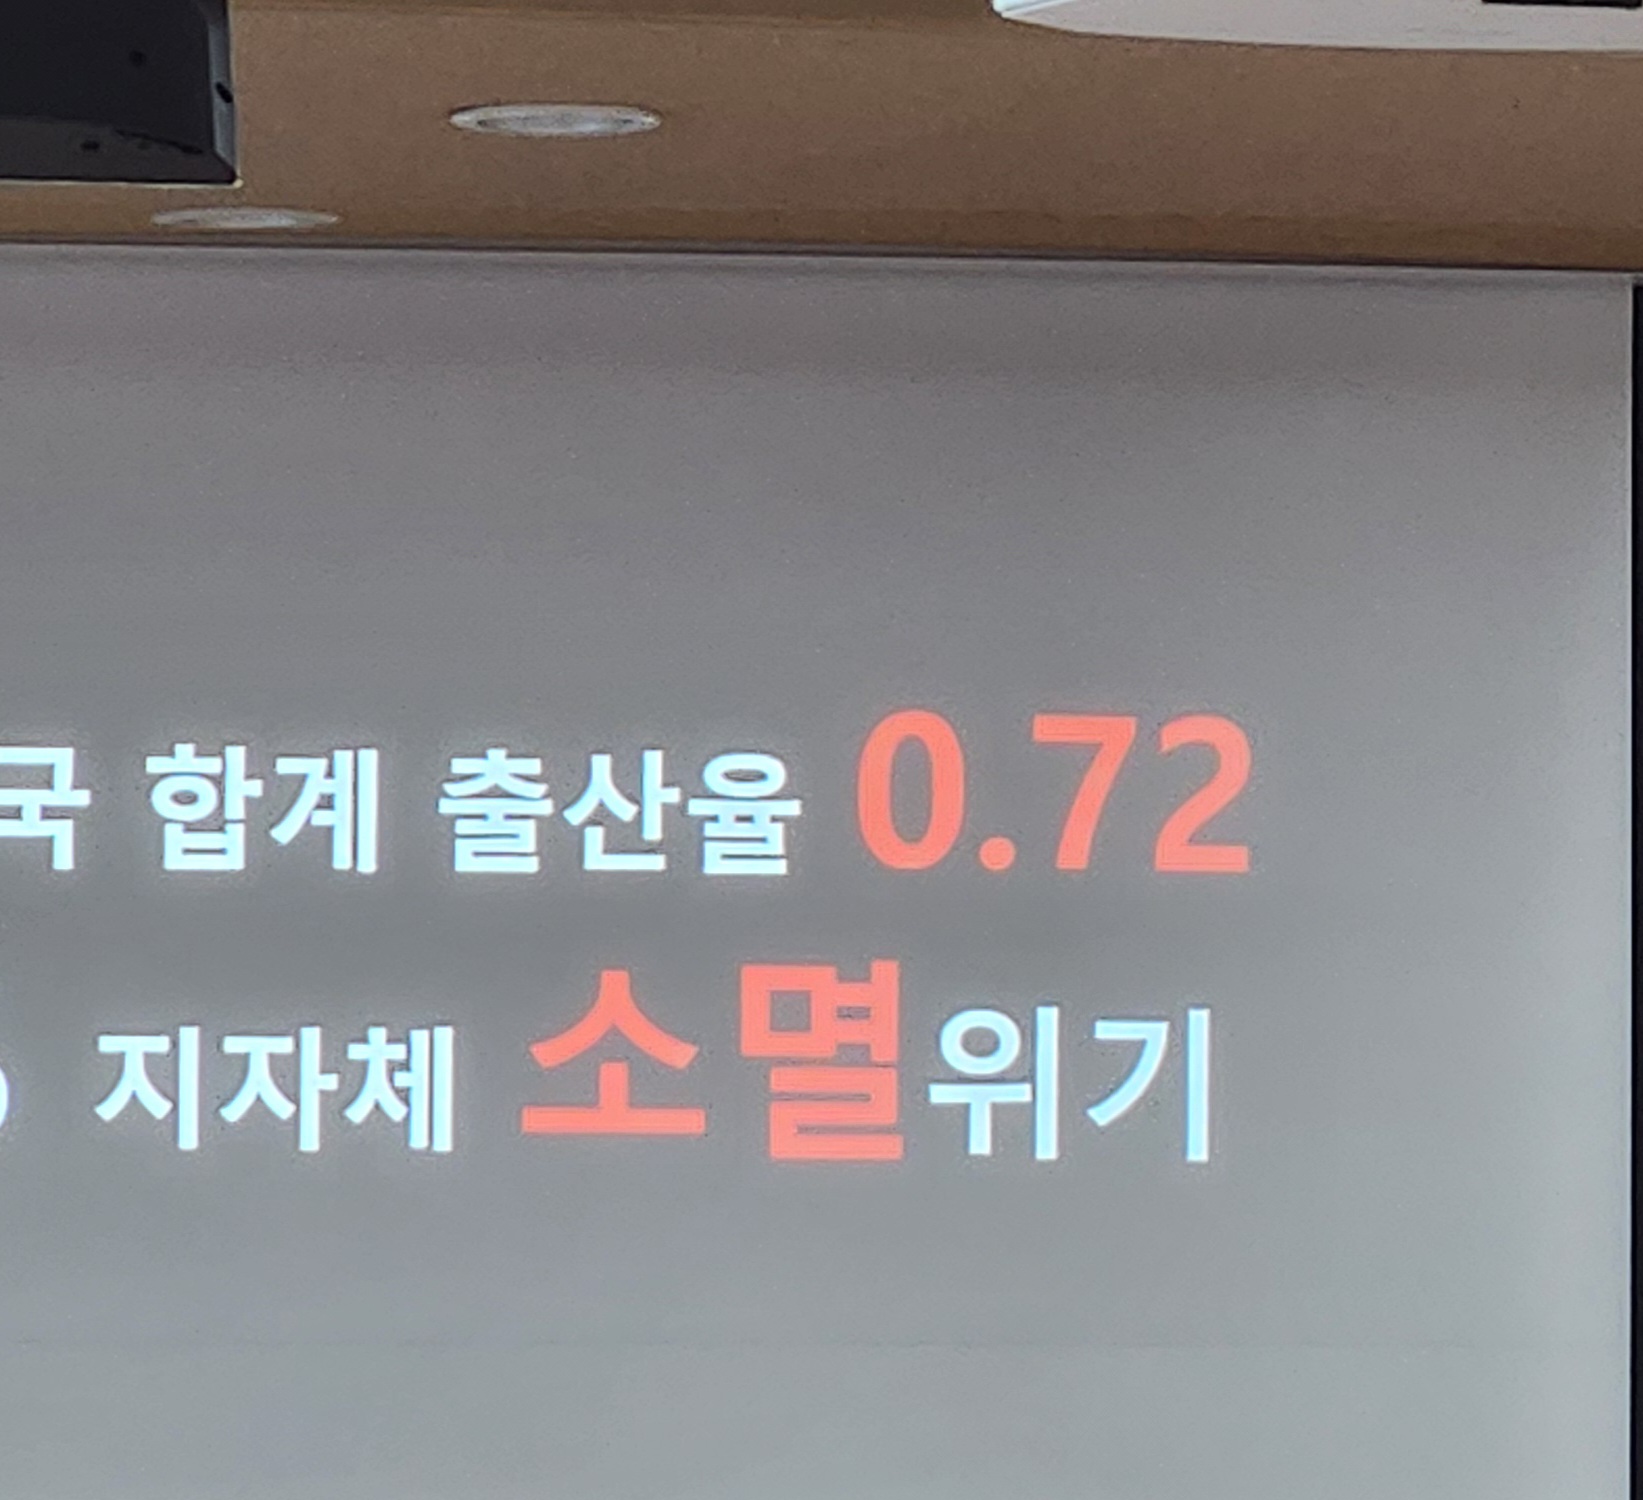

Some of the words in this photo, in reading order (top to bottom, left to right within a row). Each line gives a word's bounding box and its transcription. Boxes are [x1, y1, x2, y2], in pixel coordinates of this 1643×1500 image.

[0, 745, 92, 871] 국
[145, 743, 379, 873] 합계
[437, 746, 802, 875] 출산율
[857, 709, 1252, 874] 0.72
[94, 1025, 455, 1152] 지자체
[520, 958, 1211, 1163] 소멸위기
